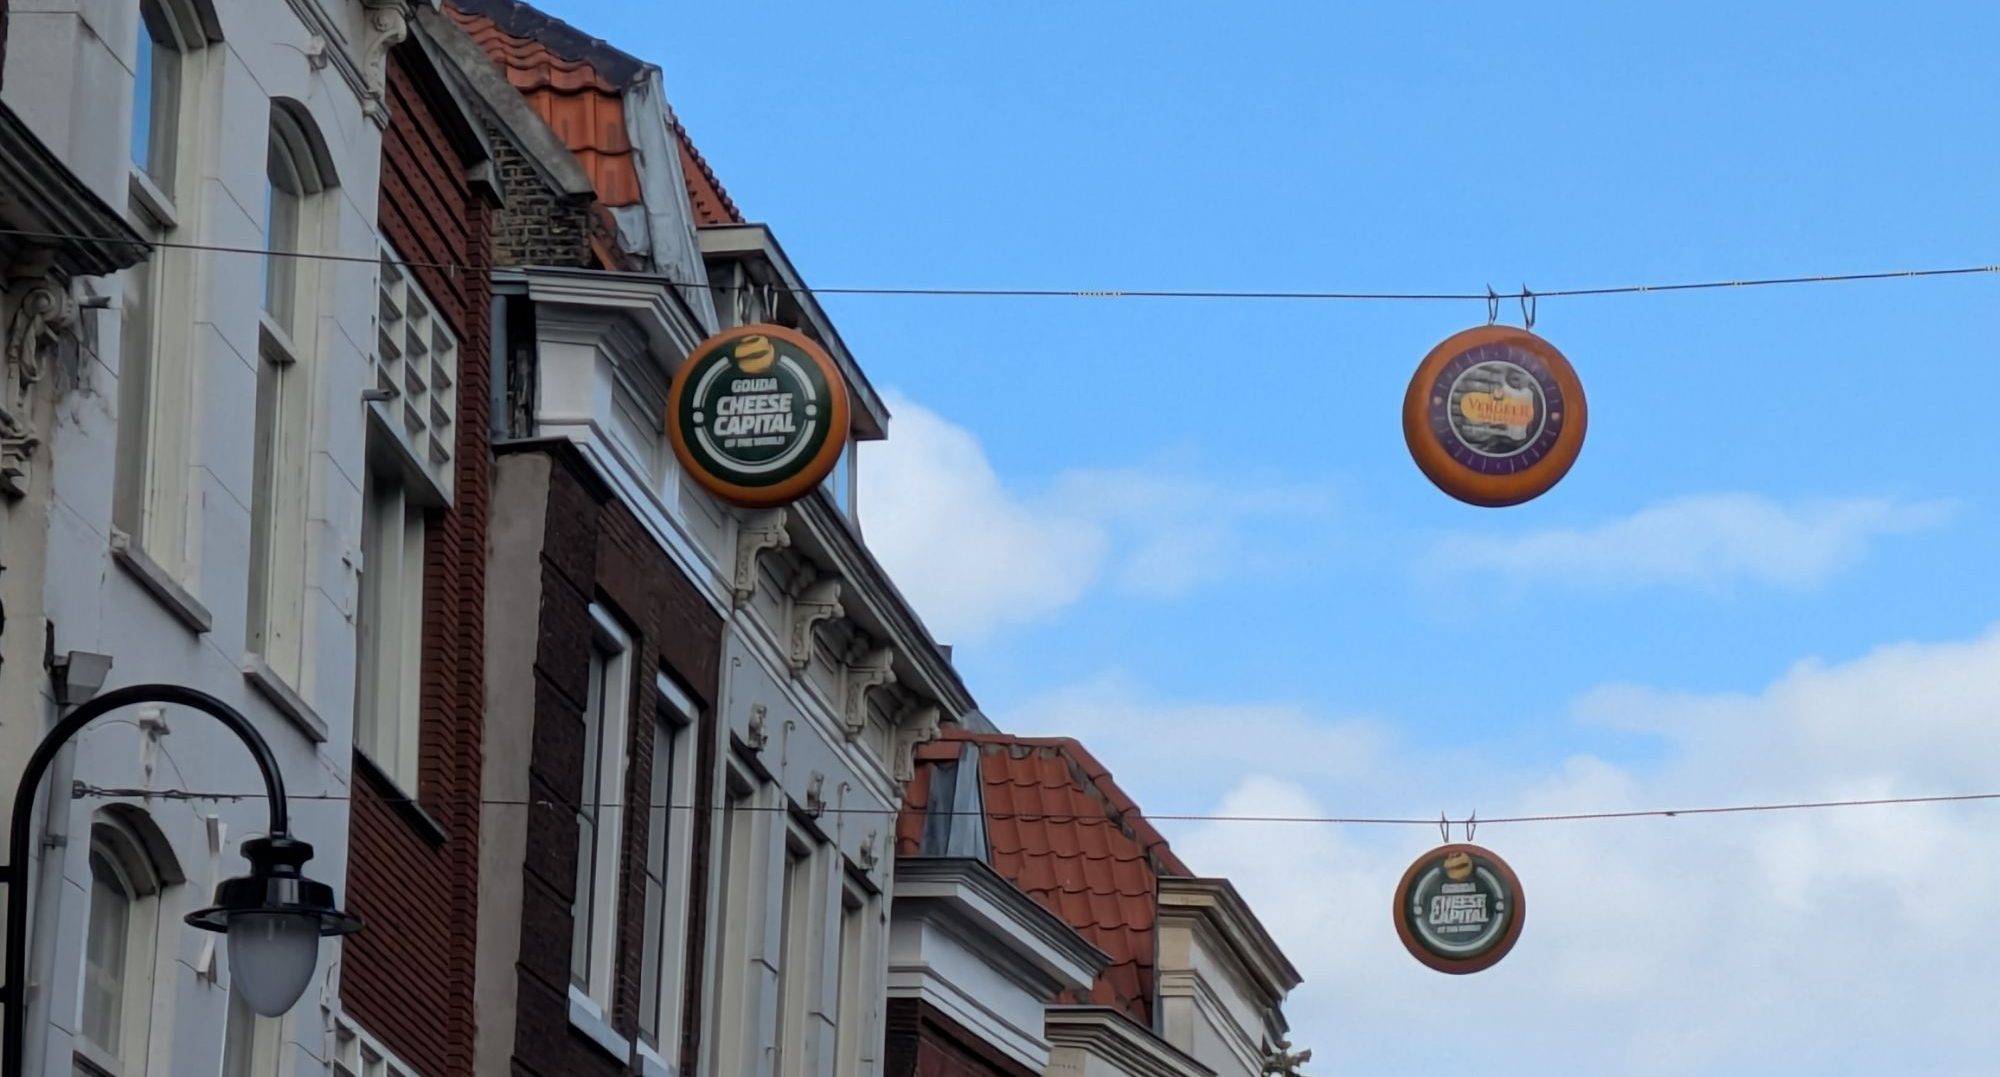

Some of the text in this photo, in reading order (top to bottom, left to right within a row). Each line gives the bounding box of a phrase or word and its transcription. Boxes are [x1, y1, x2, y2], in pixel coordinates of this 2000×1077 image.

[731, 377, 778, 393] GOUDA
[716, 393, 793, 416] CHEESE
[713, 412, 796, 436] CAPITAL
